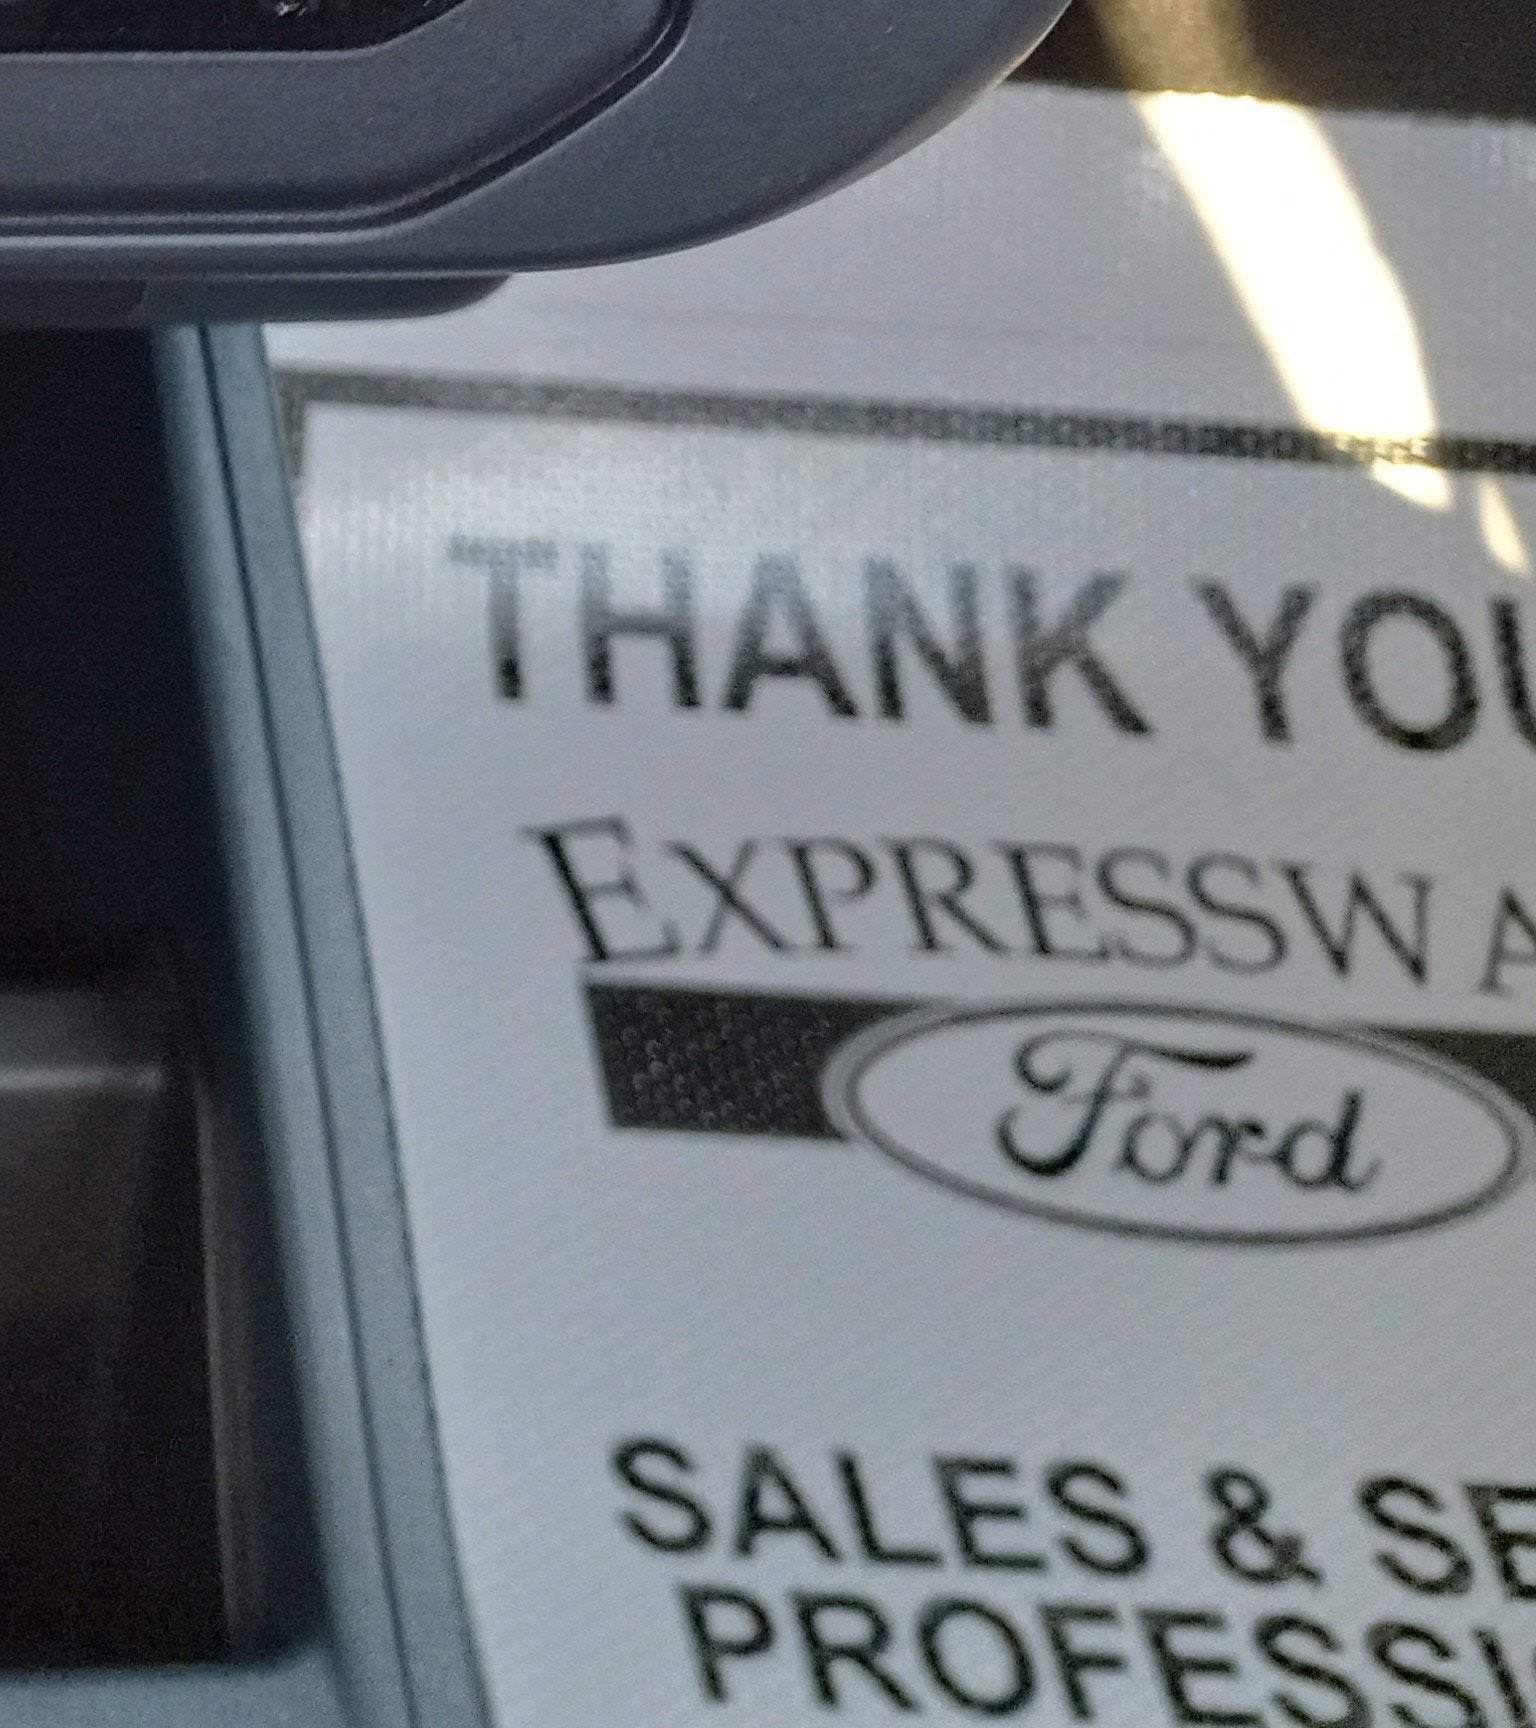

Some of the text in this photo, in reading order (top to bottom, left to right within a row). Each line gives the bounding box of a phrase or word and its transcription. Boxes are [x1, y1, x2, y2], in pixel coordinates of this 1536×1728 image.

[448, 534, 1154, 738] THANK
[996, 1028, 1382, 1194] Ford
[610, 1434, 1536, 1602] SALES & SE
